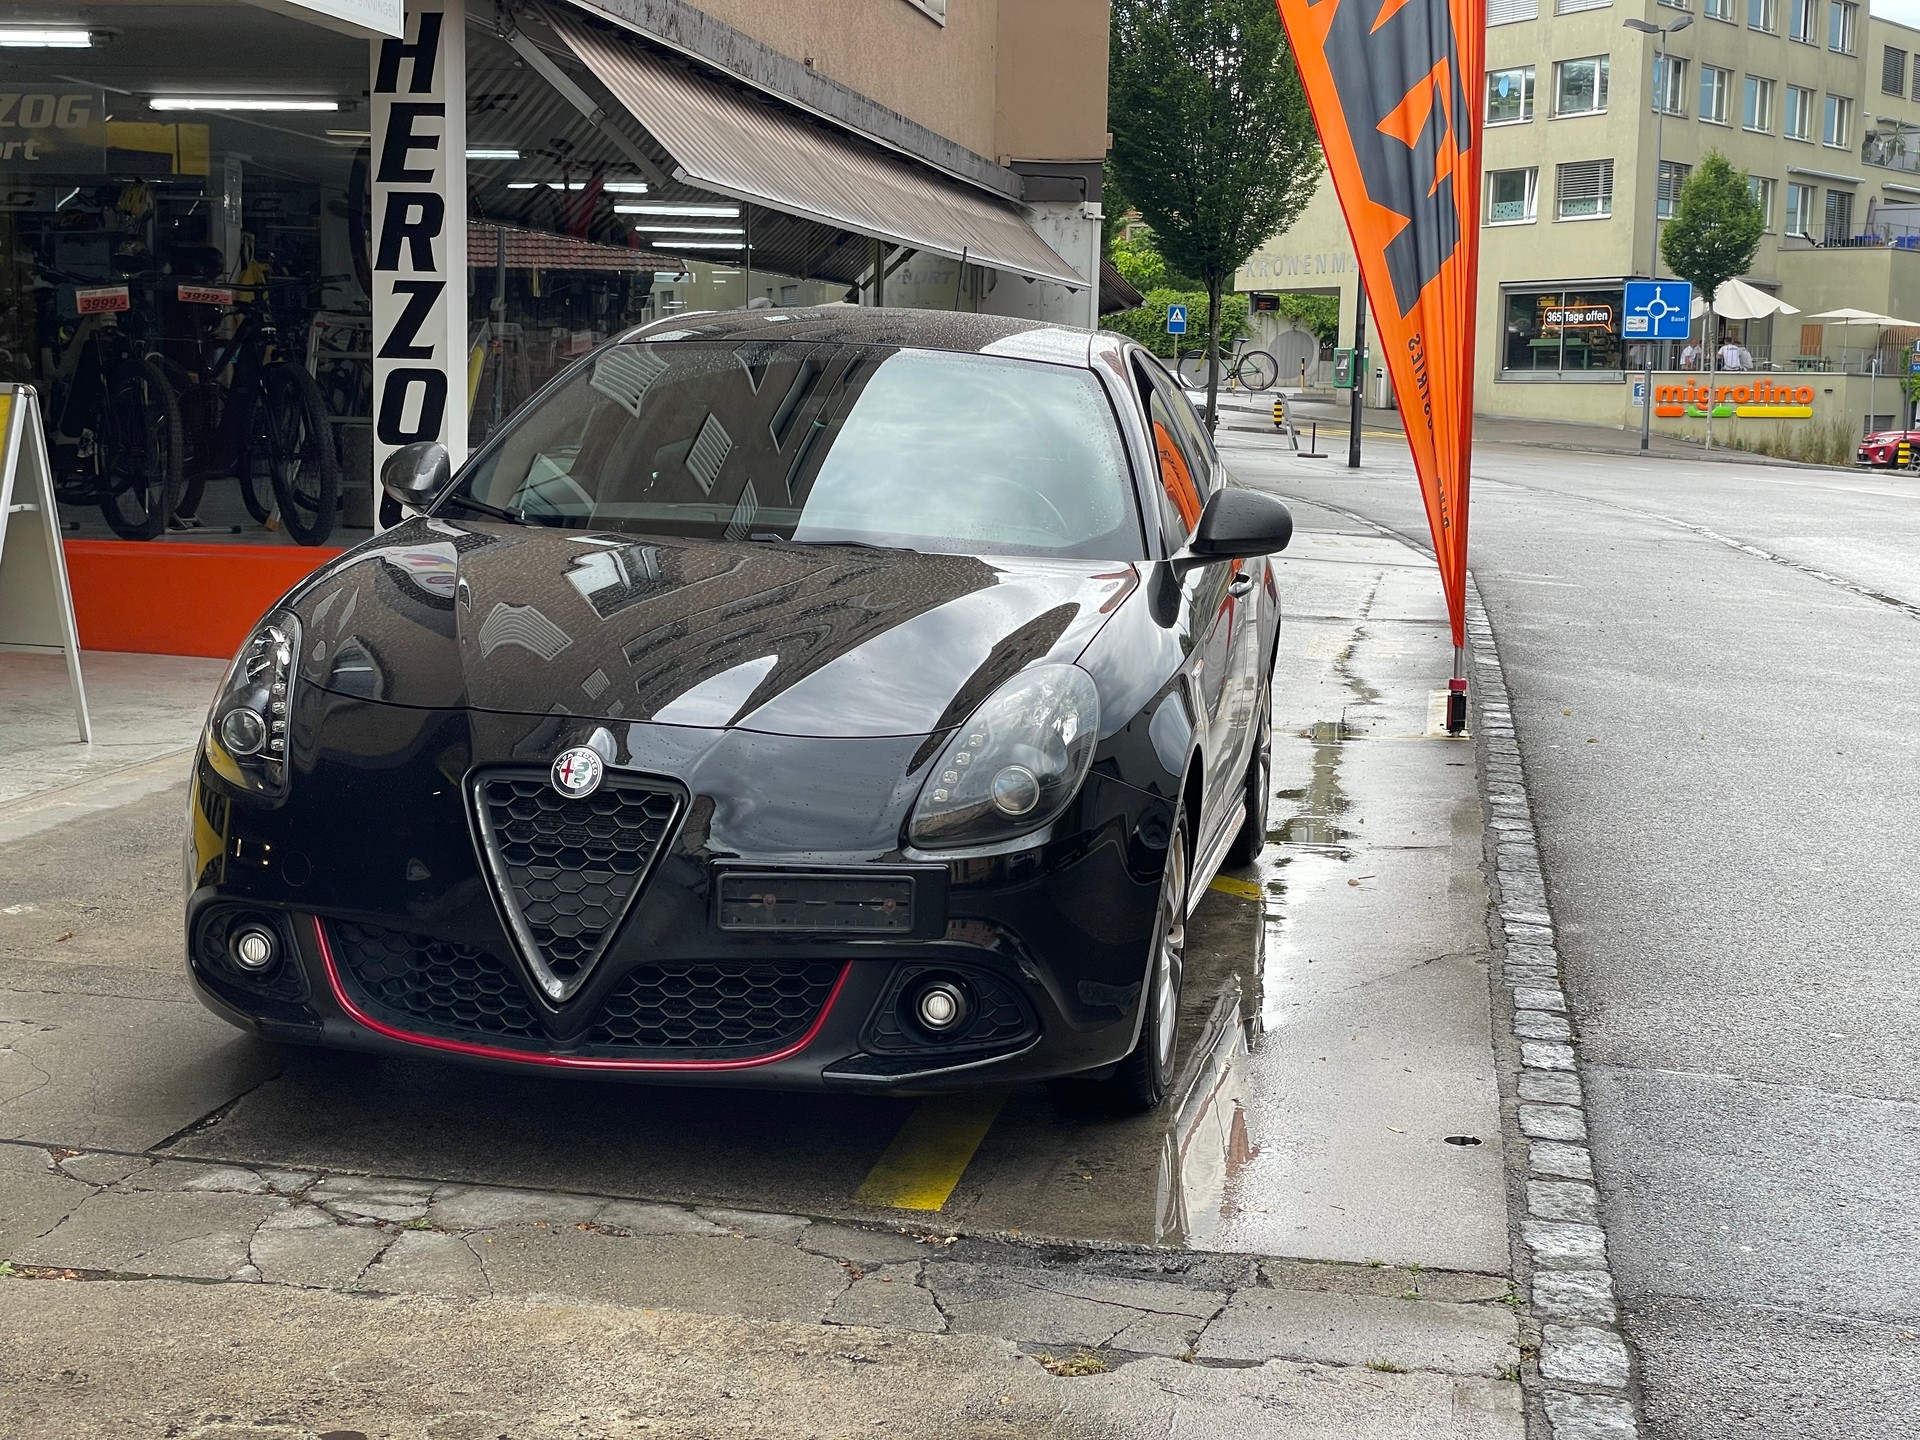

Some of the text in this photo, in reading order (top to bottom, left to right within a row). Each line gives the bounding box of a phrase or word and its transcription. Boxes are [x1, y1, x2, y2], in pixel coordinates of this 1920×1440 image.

[373, 12, 448, 532] HERZO
[82, 297, 126, 310] 3999.-
[182, 292, 229, 302] 3999.-
[1546, 310, 1608, 324] 365 Tage offen
[1655, 377, 1815, 412] migrolino
[555, 751, 599, 776] ALFA ROMEO
